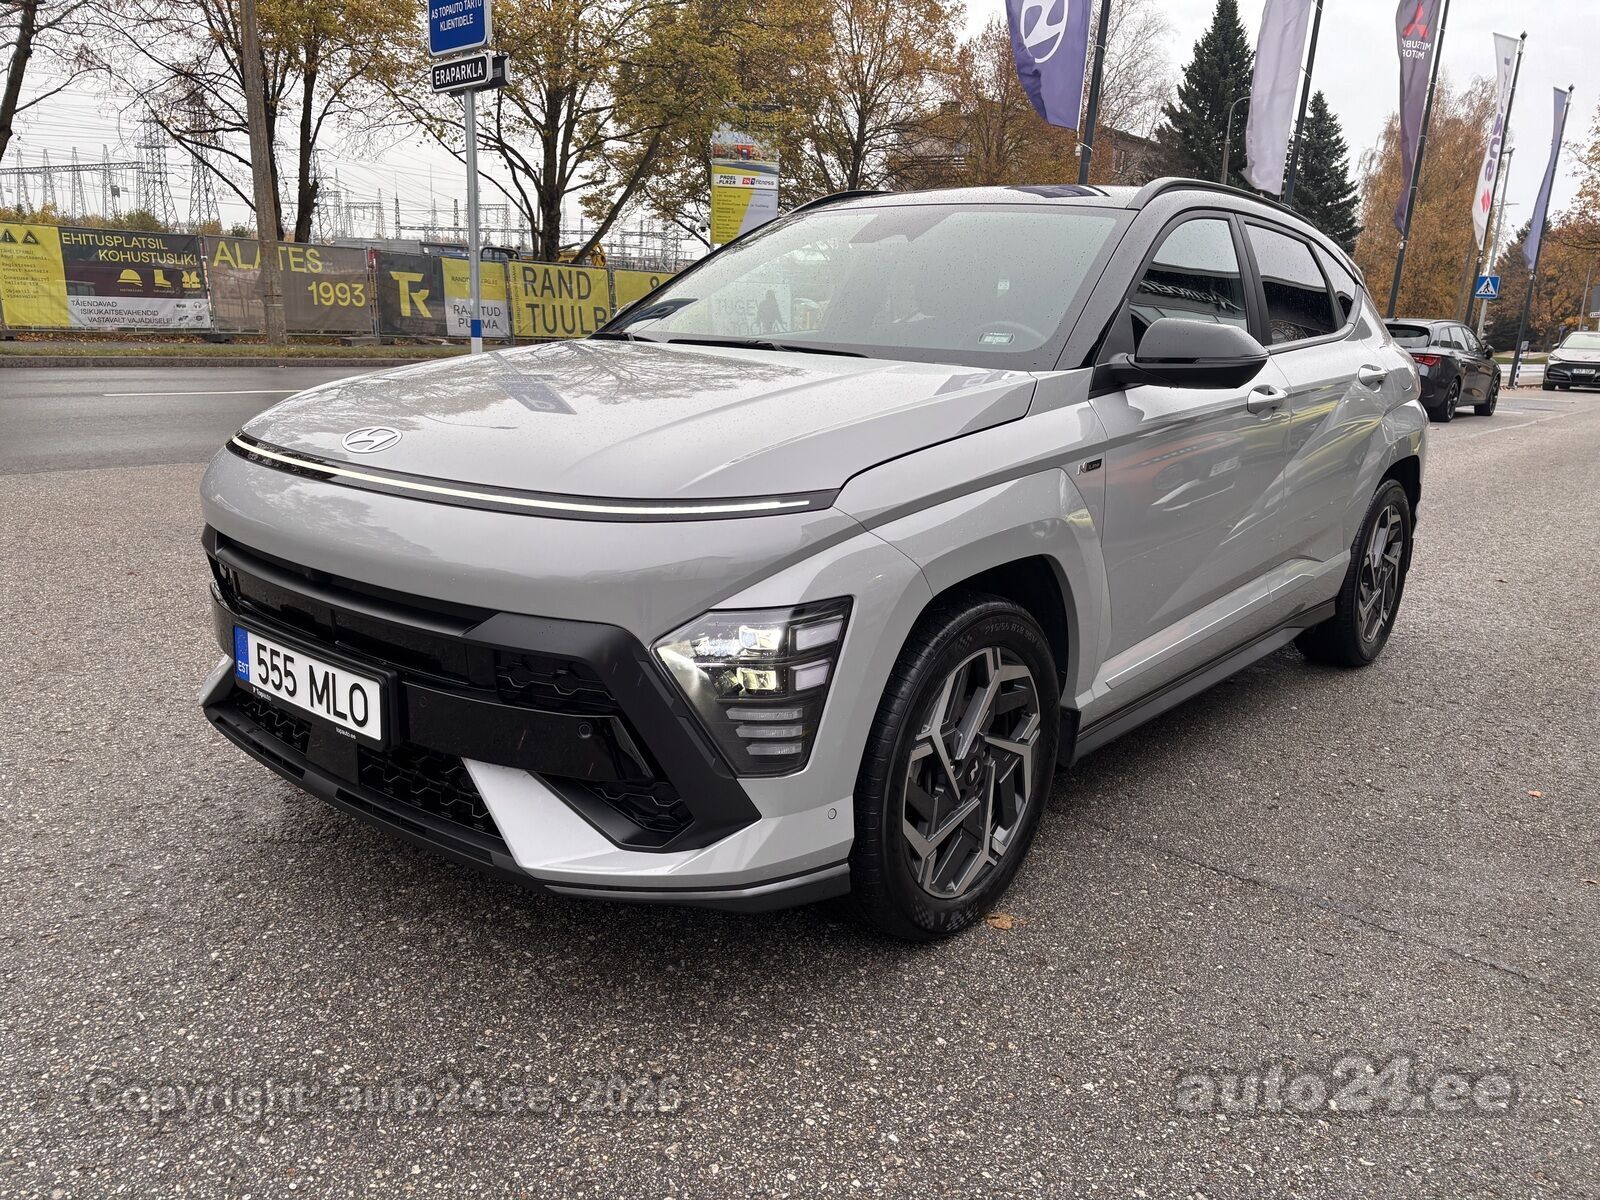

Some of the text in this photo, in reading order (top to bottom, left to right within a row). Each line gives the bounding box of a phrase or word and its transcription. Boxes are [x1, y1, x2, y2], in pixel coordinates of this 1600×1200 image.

[439, 2, 462, 18] TOPAUTO
[440, 14, 474, 31] KLIENTIDELE
[435, 61, 484, 86] ERAPARKLA
[62, 232, 168, 250] EHITUSPLATSIL
[98, 250, 198, 266] KOHUSTUSLIK!
[213, 241, 323, 274] ALTES
[522, 266, 592, 300] RAND
[308, 281, 366, 308] 1993
[238, 660, 248, 675] EST
[256, 642, 368, 728] 555 MLO
